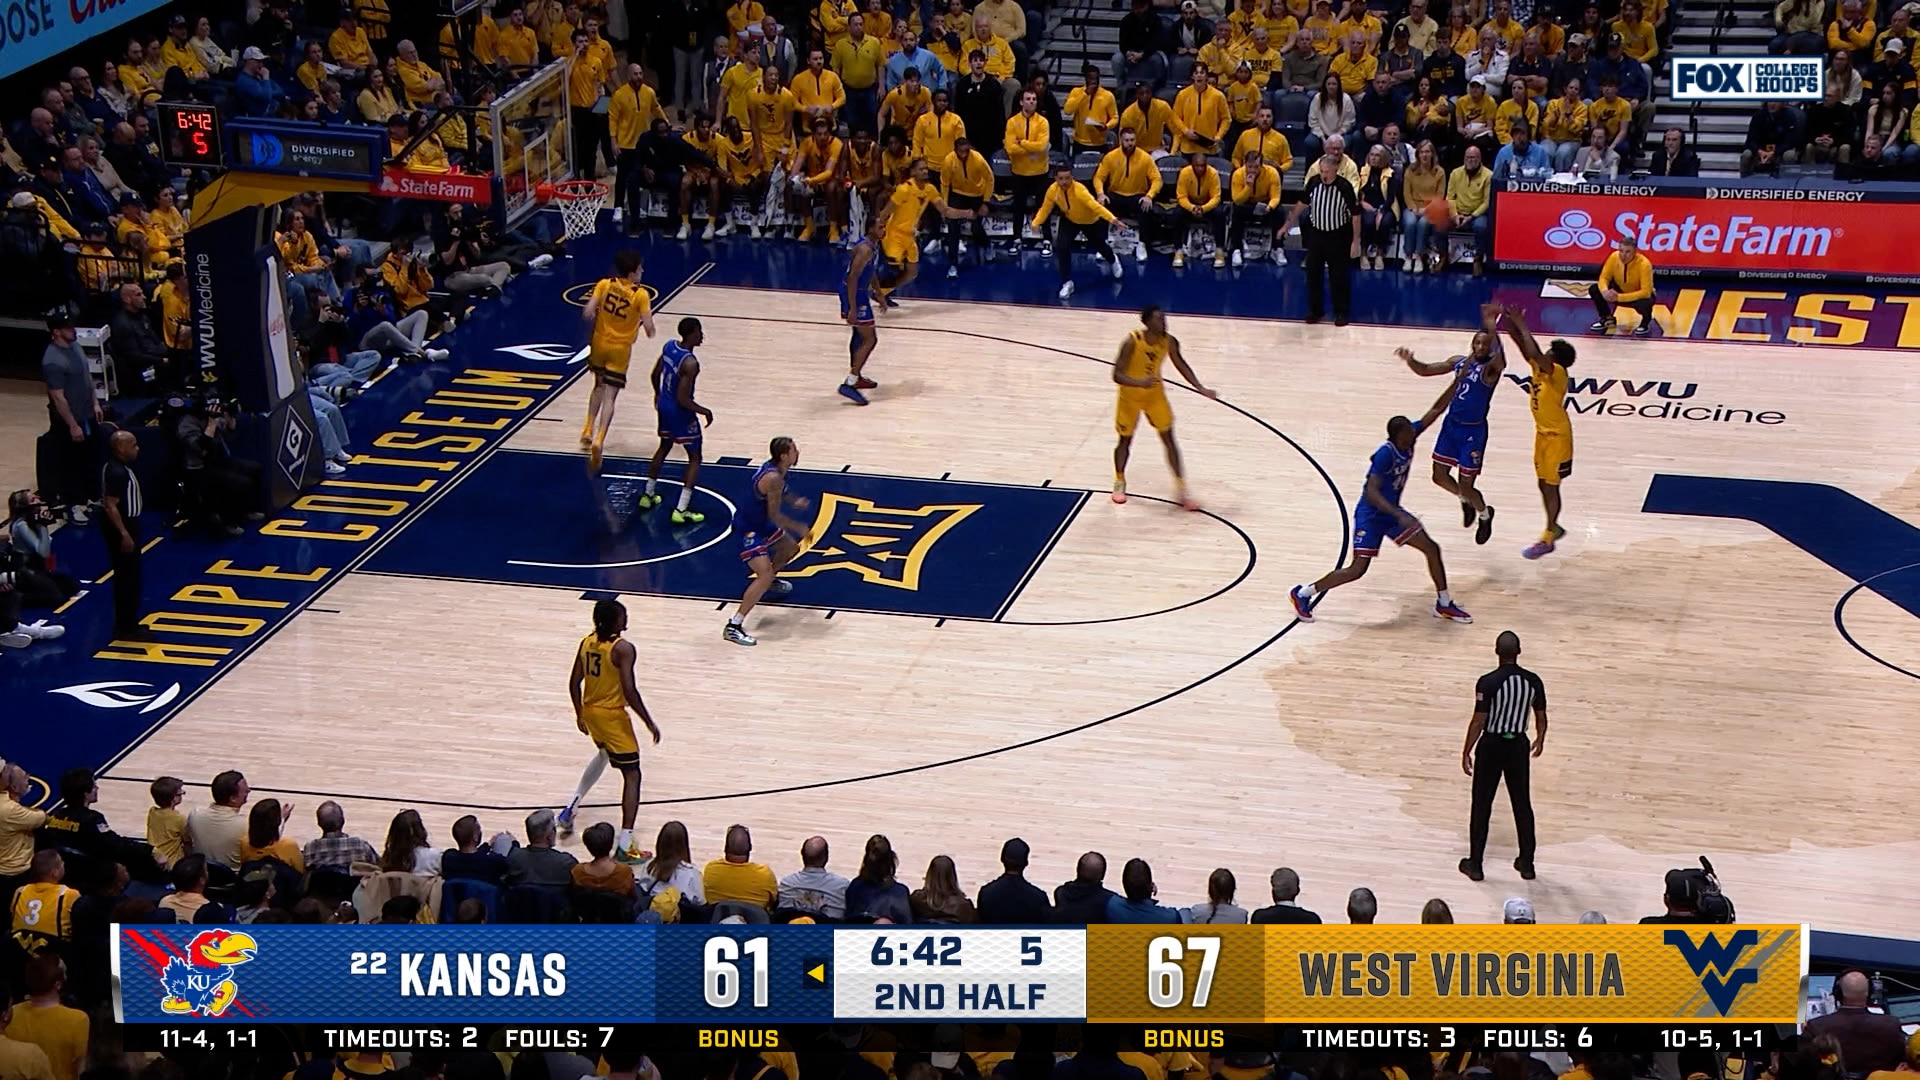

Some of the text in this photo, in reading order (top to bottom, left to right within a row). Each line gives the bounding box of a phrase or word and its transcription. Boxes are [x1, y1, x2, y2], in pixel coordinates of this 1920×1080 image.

[178, 111, 212, 131] 6:42
[192, 131, 208, 155] 5
[290, 144, 356, 158] DIVERSIFIED
[400, 177, 474, 199] StateFarm
[1520, 180, 1658, 197] DIVERSIFIED ENERGY
[1719, 187, 1865, 203] DIVERSIFIED ENERGY
[1505, 263, 1582, 273] DIVERSIFIED ENERGY
[1671, 268, 1702, 277] ENERGY
[1745, 271, 1828, 281] DIVERSIFIED ENERGY
[603, 292, 631, 320] 52
[1566, 376, 1699, 400] WVU
[1564, 396, 1787, 426] Medicine
[93, 368, 564, 667] HOPE COLISEUM
[585, 652, 602, 678] 13
[24, 899, 43, 926] 3
